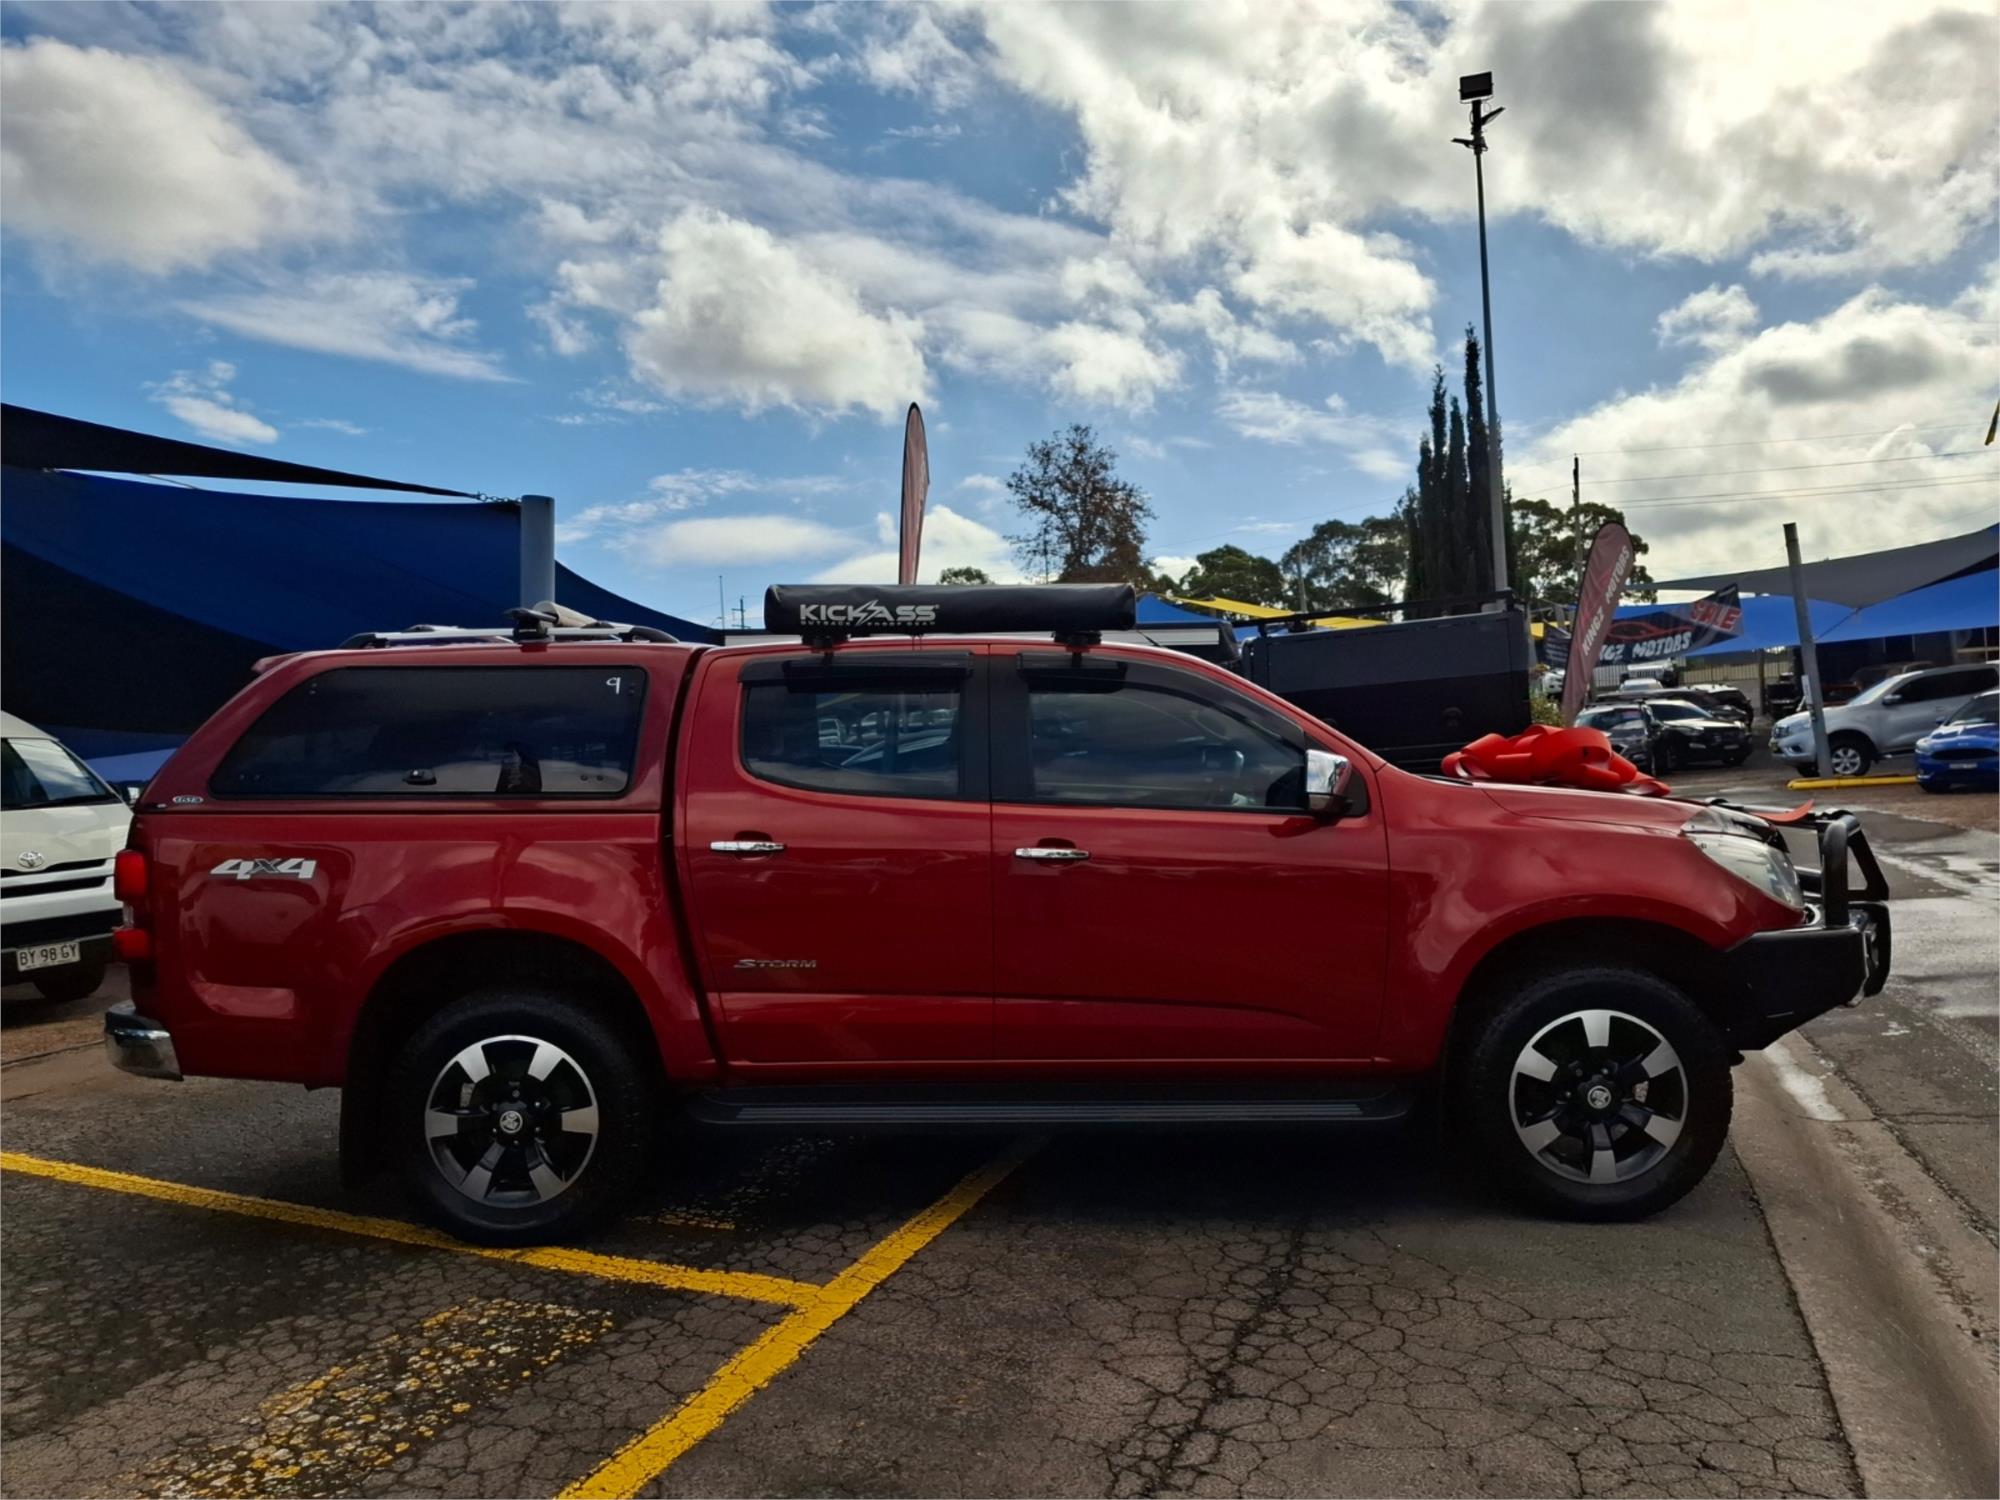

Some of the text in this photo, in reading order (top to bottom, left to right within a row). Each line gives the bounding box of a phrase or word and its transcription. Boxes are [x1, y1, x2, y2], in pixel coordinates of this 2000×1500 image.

[800, 601, 937, 624] KICKASS
[1582, 545, 1630, 656] KINGZ MOTORS
[1690, 600, 1743, 632] SALE
[1632, 631, 1692, 658] MOTORS
[20, 943, 77, 966] BY 98 GY
[733, 958, 817, 969] STORM
